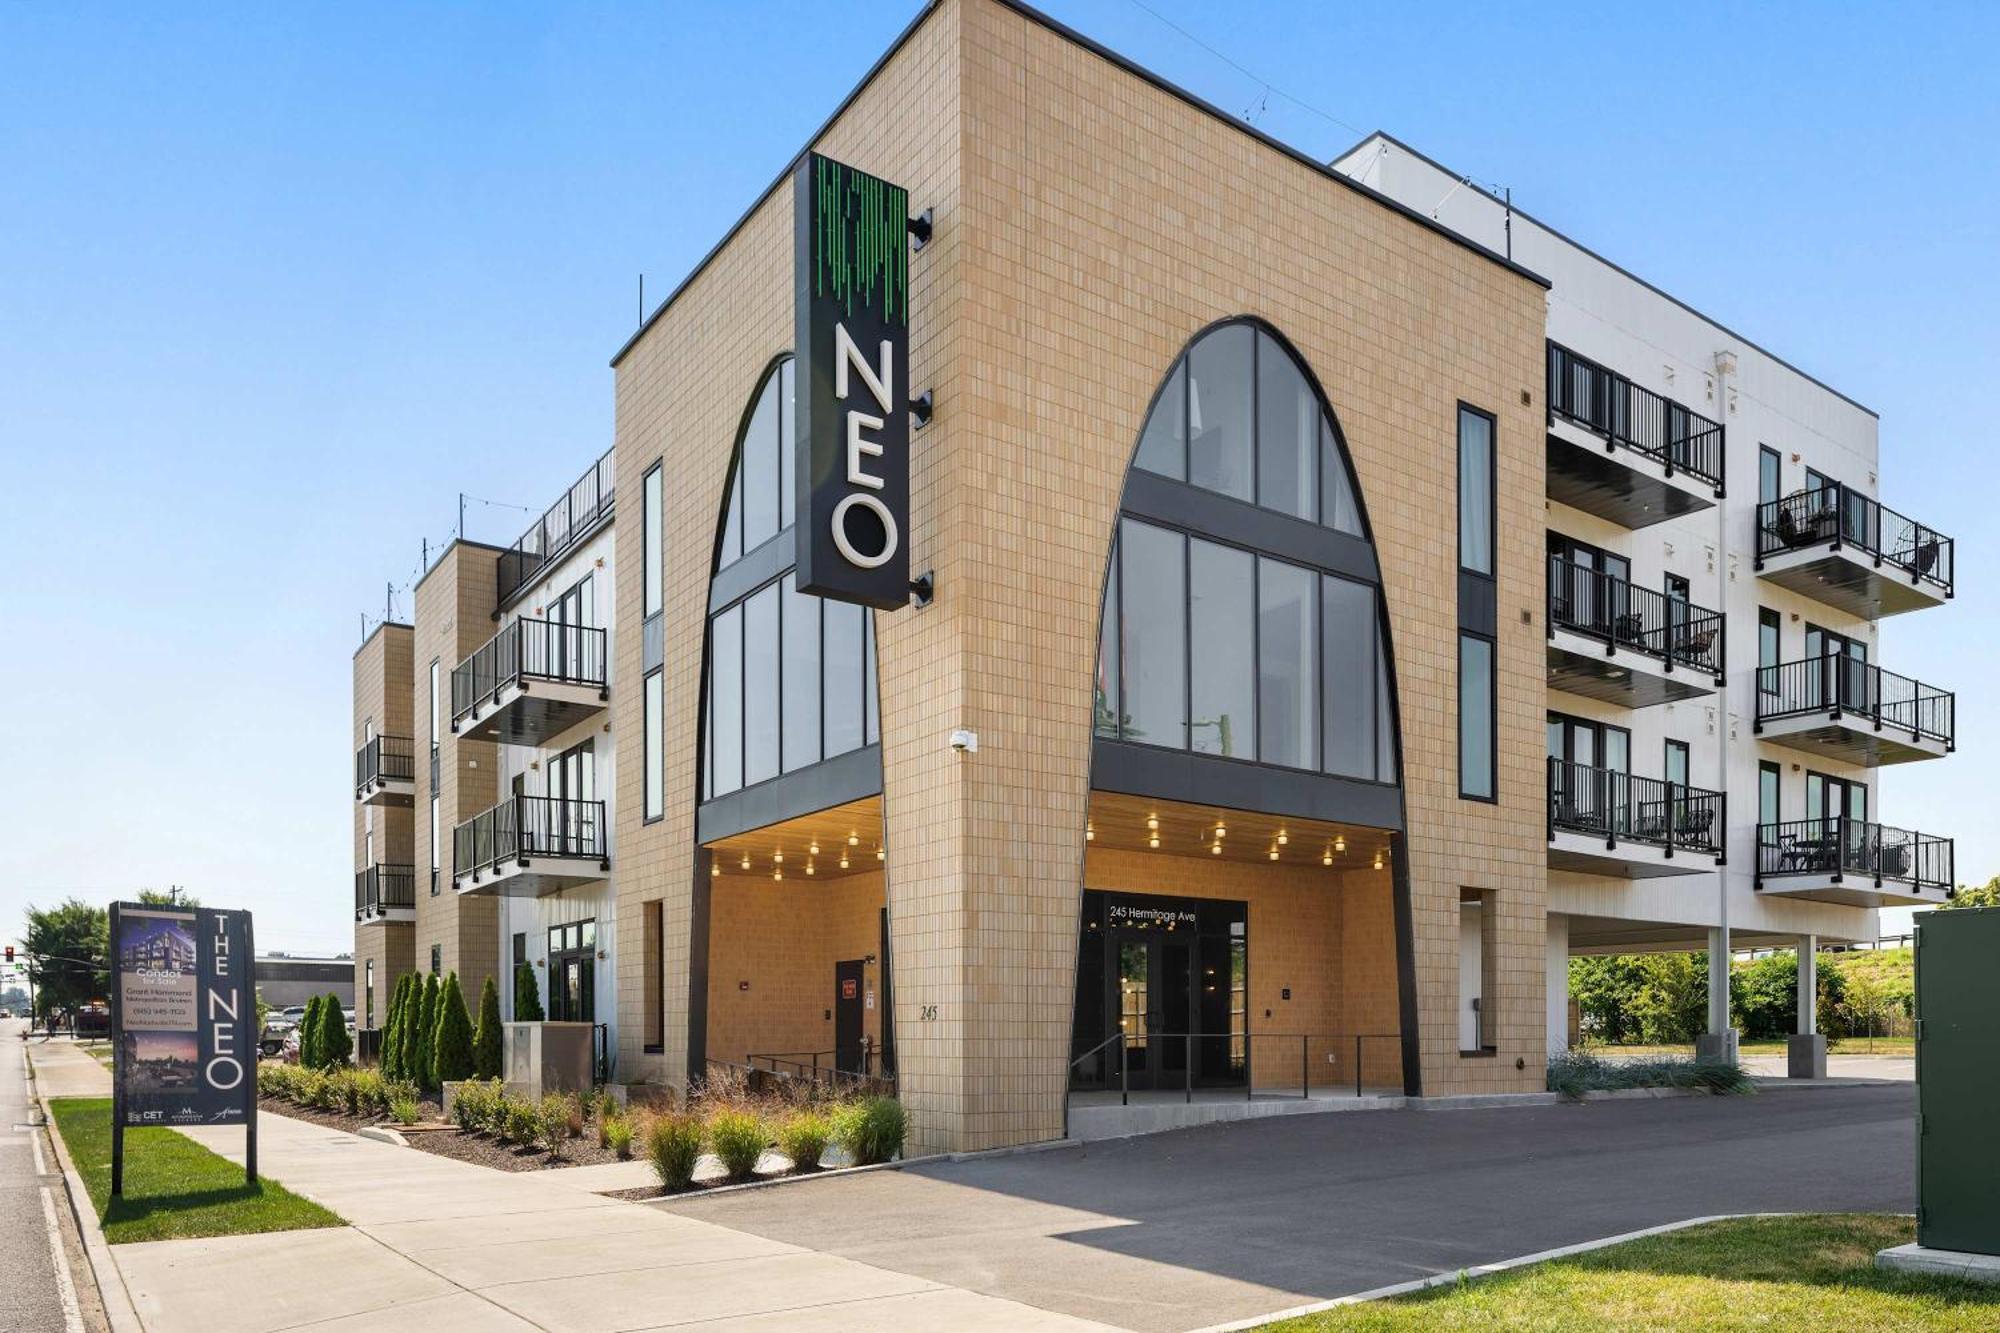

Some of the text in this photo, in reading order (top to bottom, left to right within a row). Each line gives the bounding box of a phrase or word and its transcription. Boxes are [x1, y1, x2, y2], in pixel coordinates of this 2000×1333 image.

[831, 321, 898, 569] NEO
[1110, 906, 1196, 922] 245 Hermitage Ave
[214, 914, 229, 976] THE
[136, 968, 182, 978] Condos
[920, 1005, 938, 1021] 245
[206, 988, 243, 1090] NEO
[143, 1111, 164, 1119] CET
